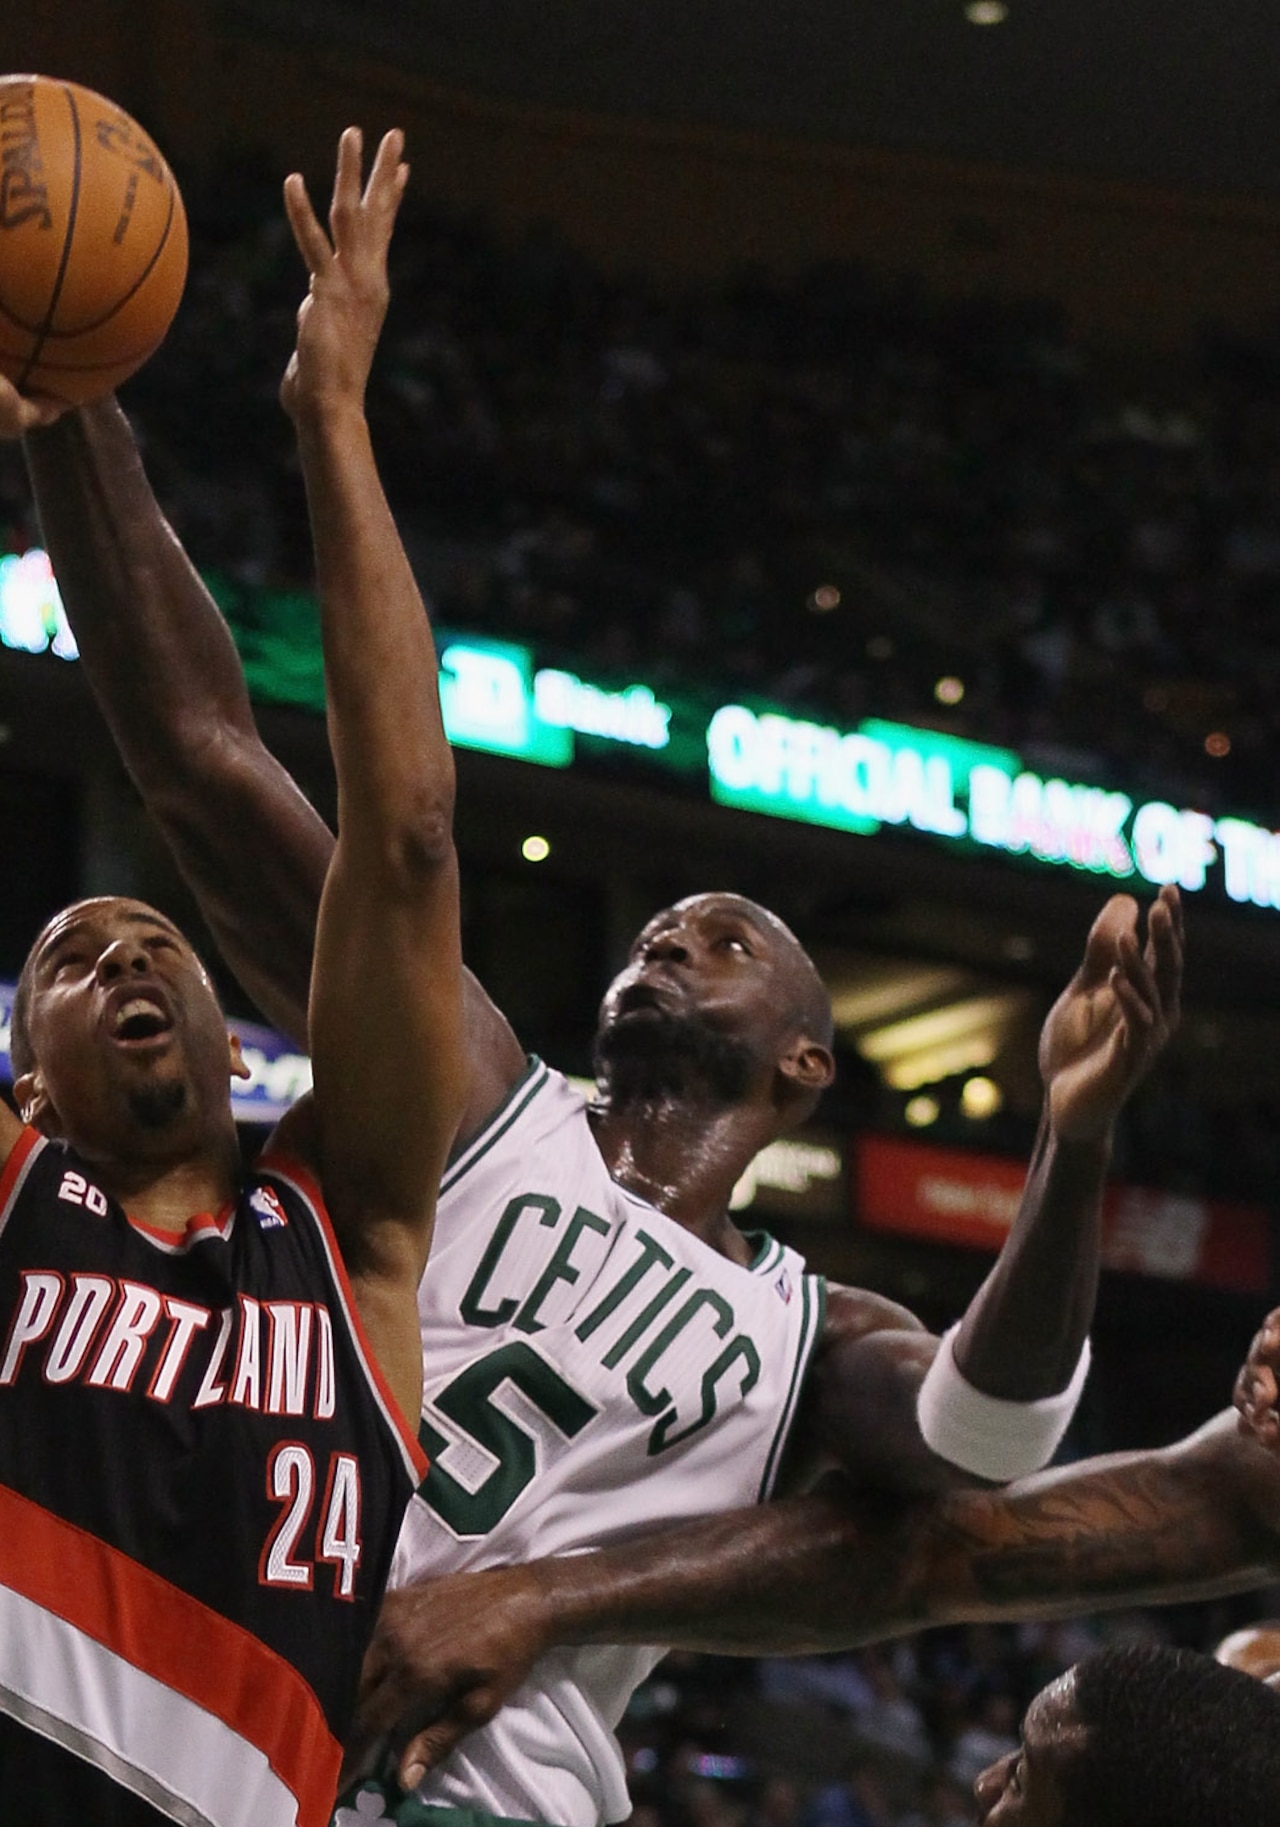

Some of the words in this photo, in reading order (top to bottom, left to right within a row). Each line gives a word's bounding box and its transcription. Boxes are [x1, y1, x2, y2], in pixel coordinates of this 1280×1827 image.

[706, 704, 968, 838] OFFICIAL
[969, 764, 1135, 878] BANK
[1132, 800, 1218, 892] OF
[1214, 816, 1280, 912] TH
[57, 1169, 109, 1218] 20
[458, 1191, 762, 1457] CETICS
[257, 1440, 362, 1602] 24
[417, 1339, 604, 1541] 5
